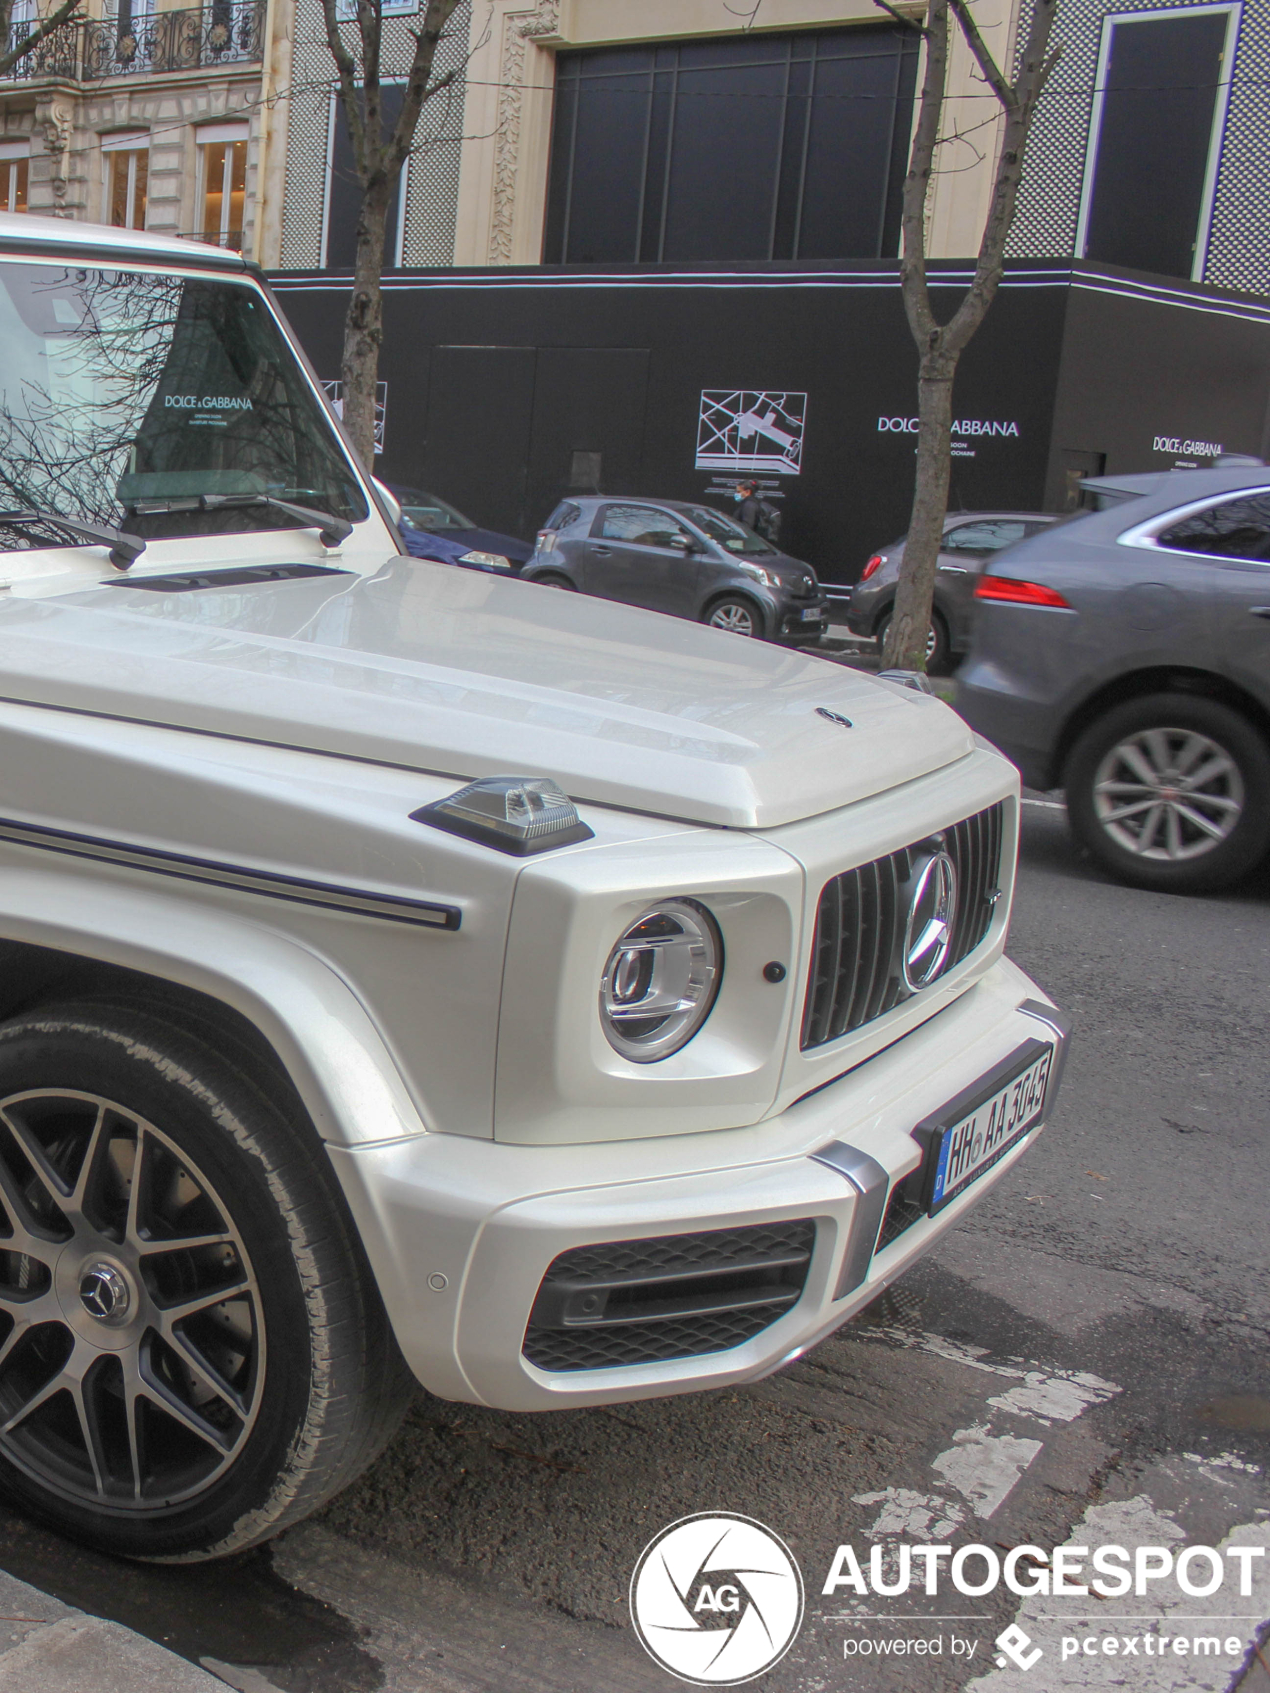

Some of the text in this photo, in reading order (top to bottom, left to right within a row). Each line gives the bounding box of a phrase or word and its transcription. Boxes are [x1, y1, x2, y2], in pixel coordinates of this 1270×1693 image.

[877, 417, 1019, 437] DOLC ABBANA
[946, 1056, 1048, 1185] HH AA 3045
[935, 1174, 943, 1190] D
